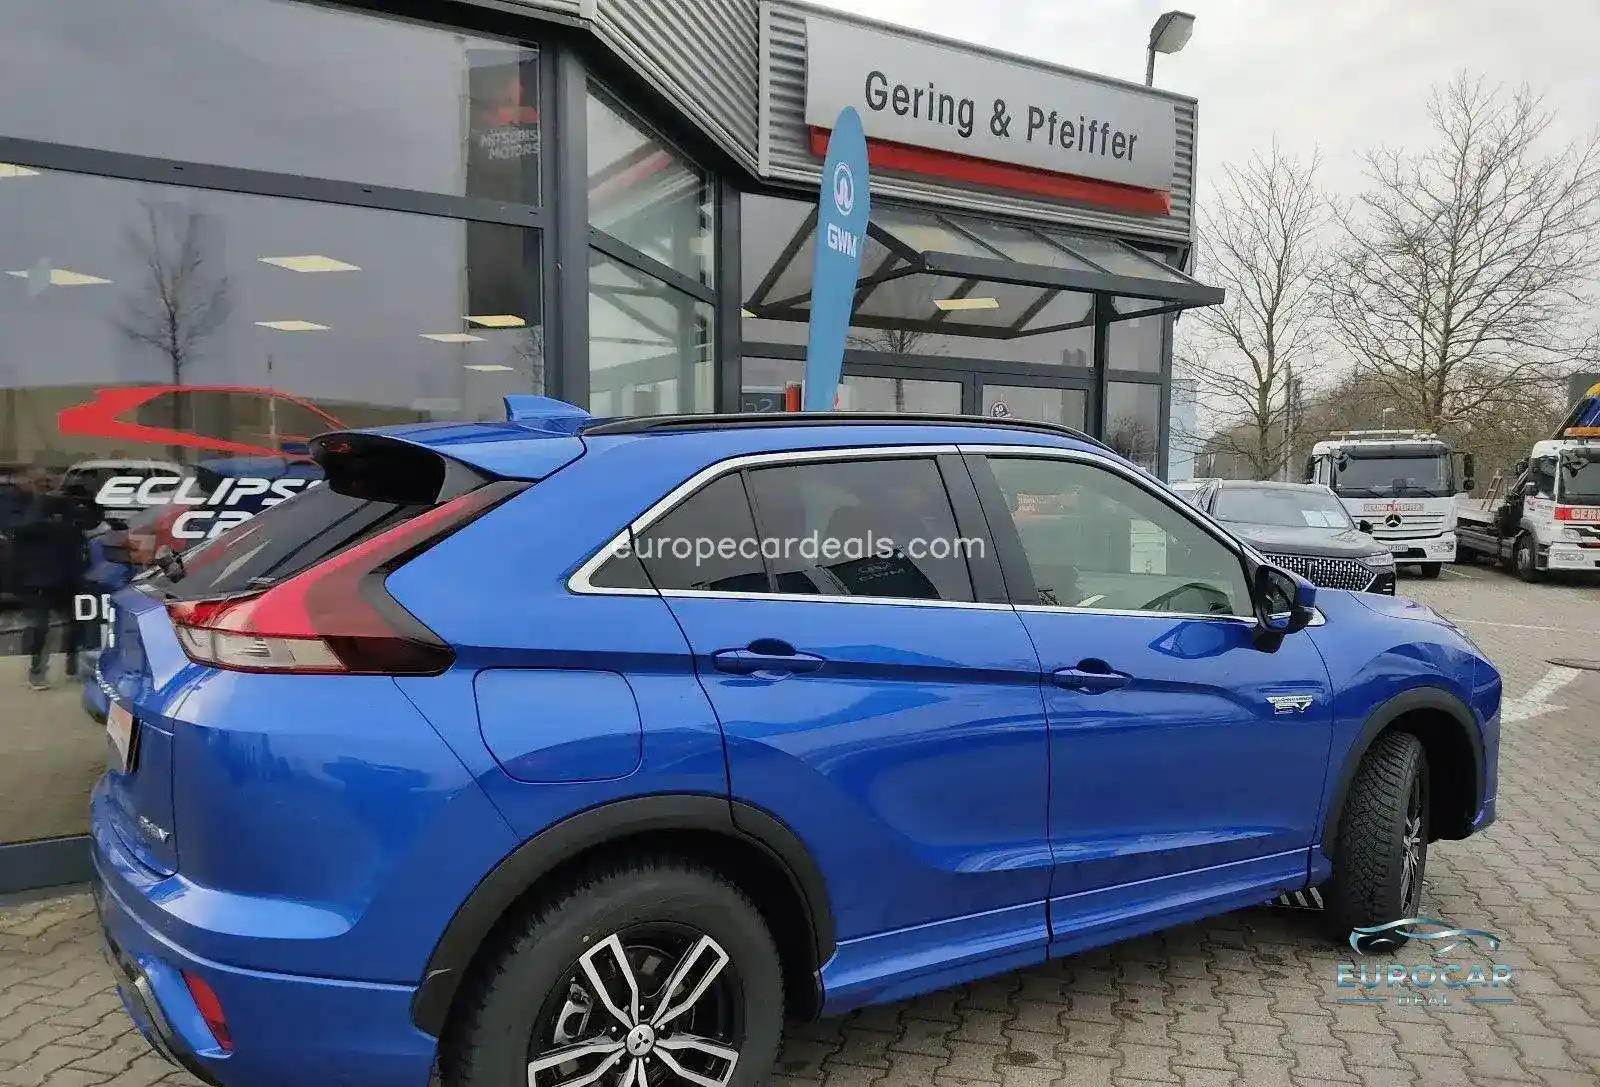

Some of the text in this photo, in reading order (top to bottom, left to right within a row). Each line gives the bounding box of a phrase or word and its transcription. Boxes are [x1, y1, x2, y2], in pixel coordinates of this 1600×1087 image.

[865, 70, 1139, 161] Gering & Pfeiffer
[827, 222, 858, 259] GWM
[95, 476, 323, 505] ECLIPS
